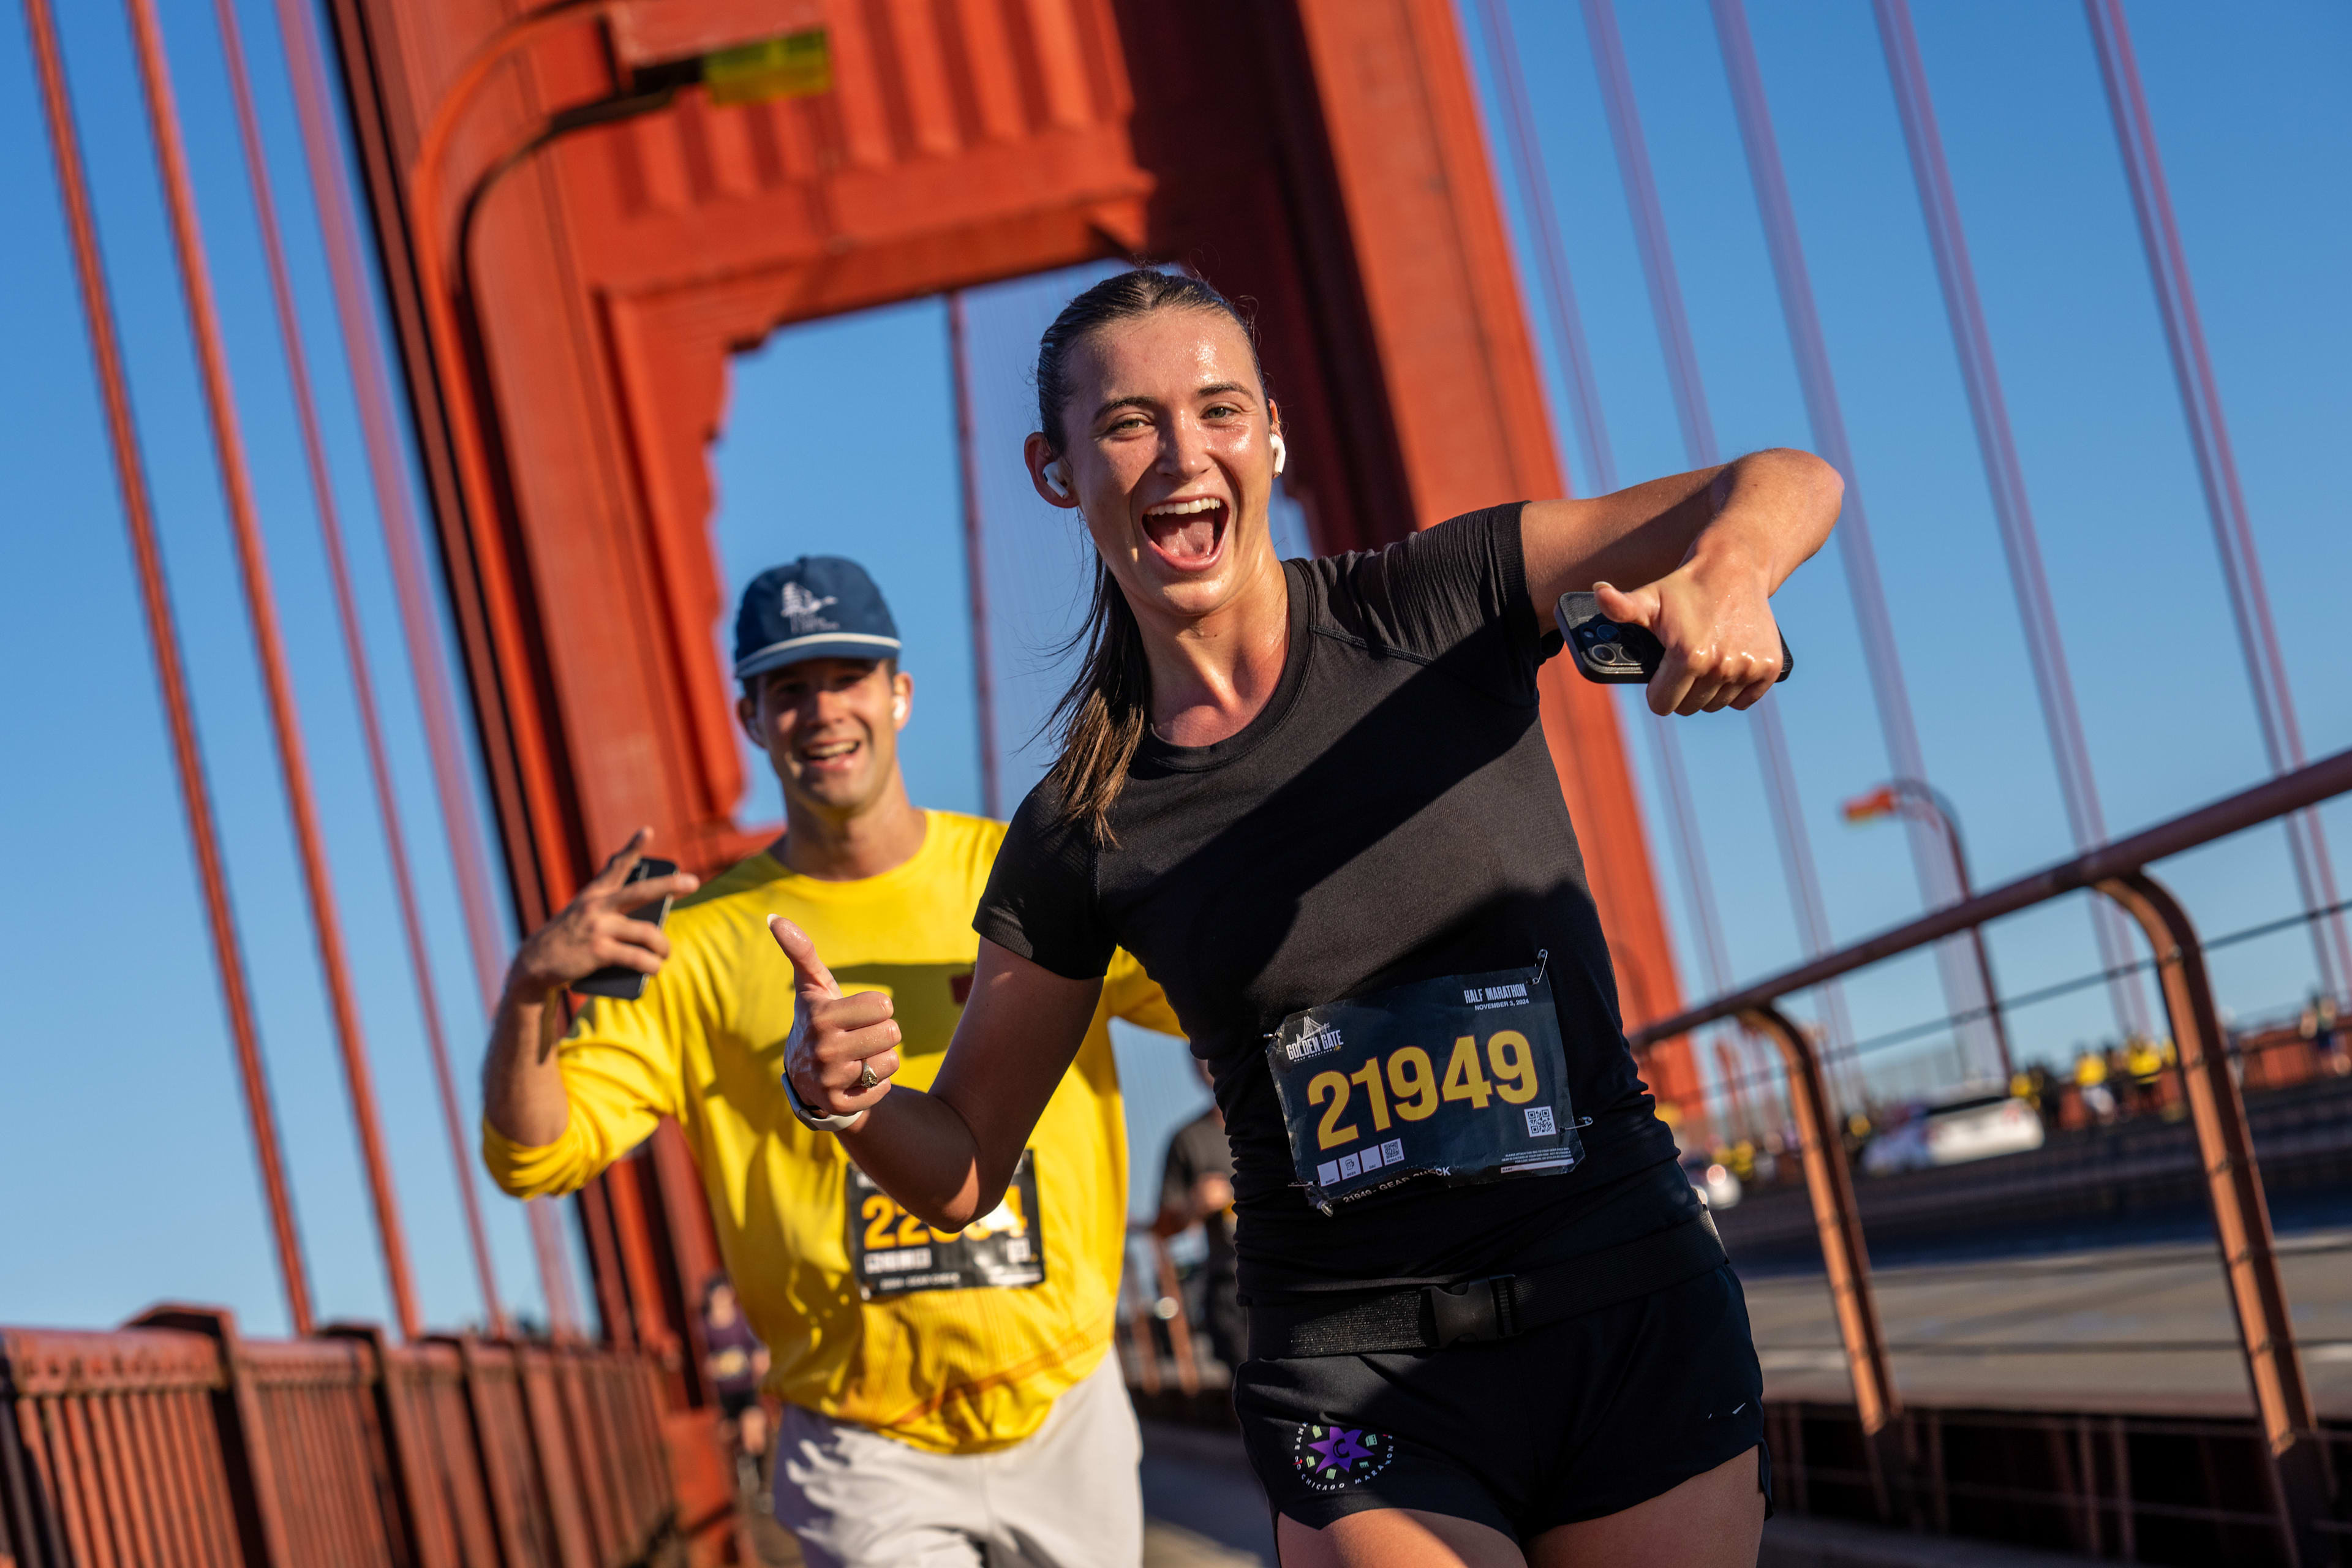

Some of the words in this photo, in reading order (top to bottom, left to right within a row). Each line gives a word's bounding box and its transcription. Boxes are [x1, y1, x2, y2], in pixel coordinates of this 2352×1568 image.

[1464, 989, 1483, 1004] HALF
[1485, 983, 1528, 1001] MARATHON
[1474, 1000, 1509, 1011] NOVEMBER
[1286, 1036, 1321, 1060] GOLDEN
[1321, 1029, 1344, 1050] GATE
[1306, 1030, 1539, 1151] 21949
[1302, 1474, 1344, 1491] CHICAGO
